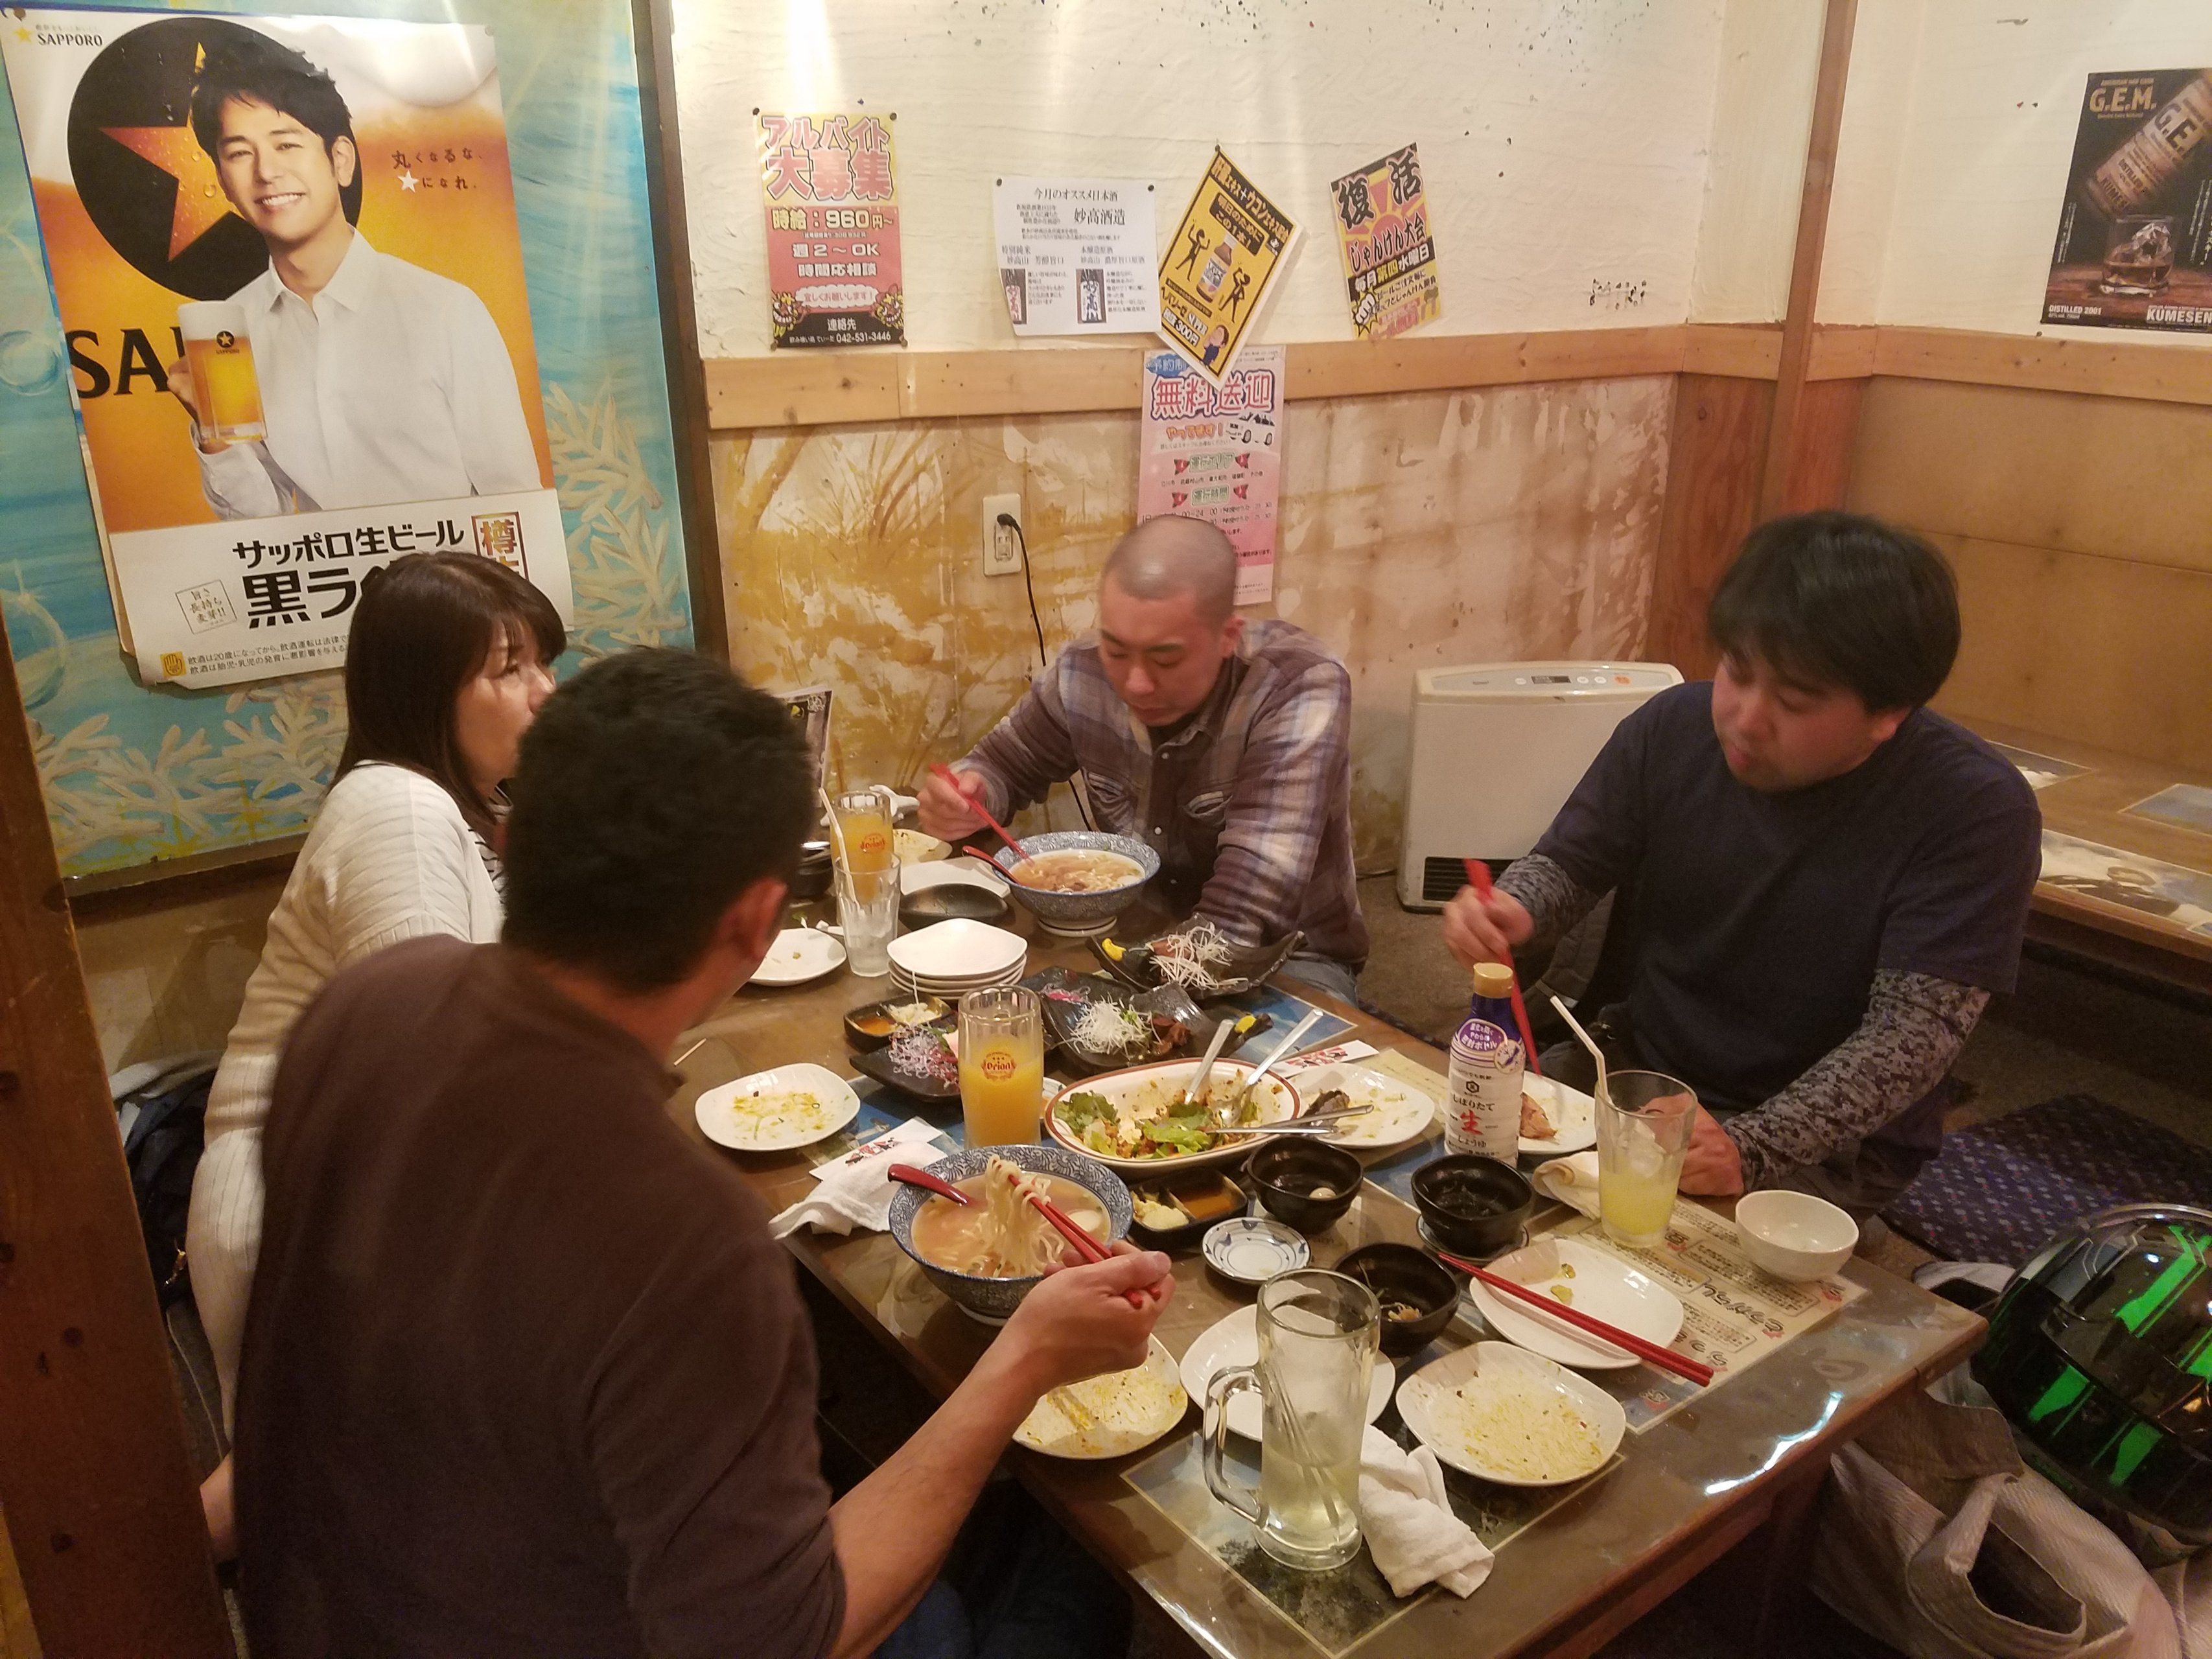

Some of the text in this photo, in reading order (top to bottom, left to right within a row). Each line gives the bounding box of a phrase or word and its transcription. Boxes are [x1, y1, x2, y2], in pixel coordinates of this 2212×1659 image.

[38, 33, 103, 46] SAPPORO
[2090, 86, 2157, 113] G.E.M.
[762, 115, 890, 150] アルバイト
[766, 146, 894, 200] 大募集
[1034, 187, 1118, 202] 今月のオススメ日本酒
[1338, 151, 1421, 229] 復活
[1074, 207, 1126, 226] 妙高酒造
[1351, 212, 1425, 272] じゃんけん大会
[65, 326, 186, 399] SA
[1154, 373, 1272, 413] 無料送迎
[232, 519, 465, 569] サッポロ生ビール
[987, 1061, 1010, 1071] Orion
[1460, 1109, 1484, 1135] 生
[1458, 1135, 1487, 1148] しょうゆ
